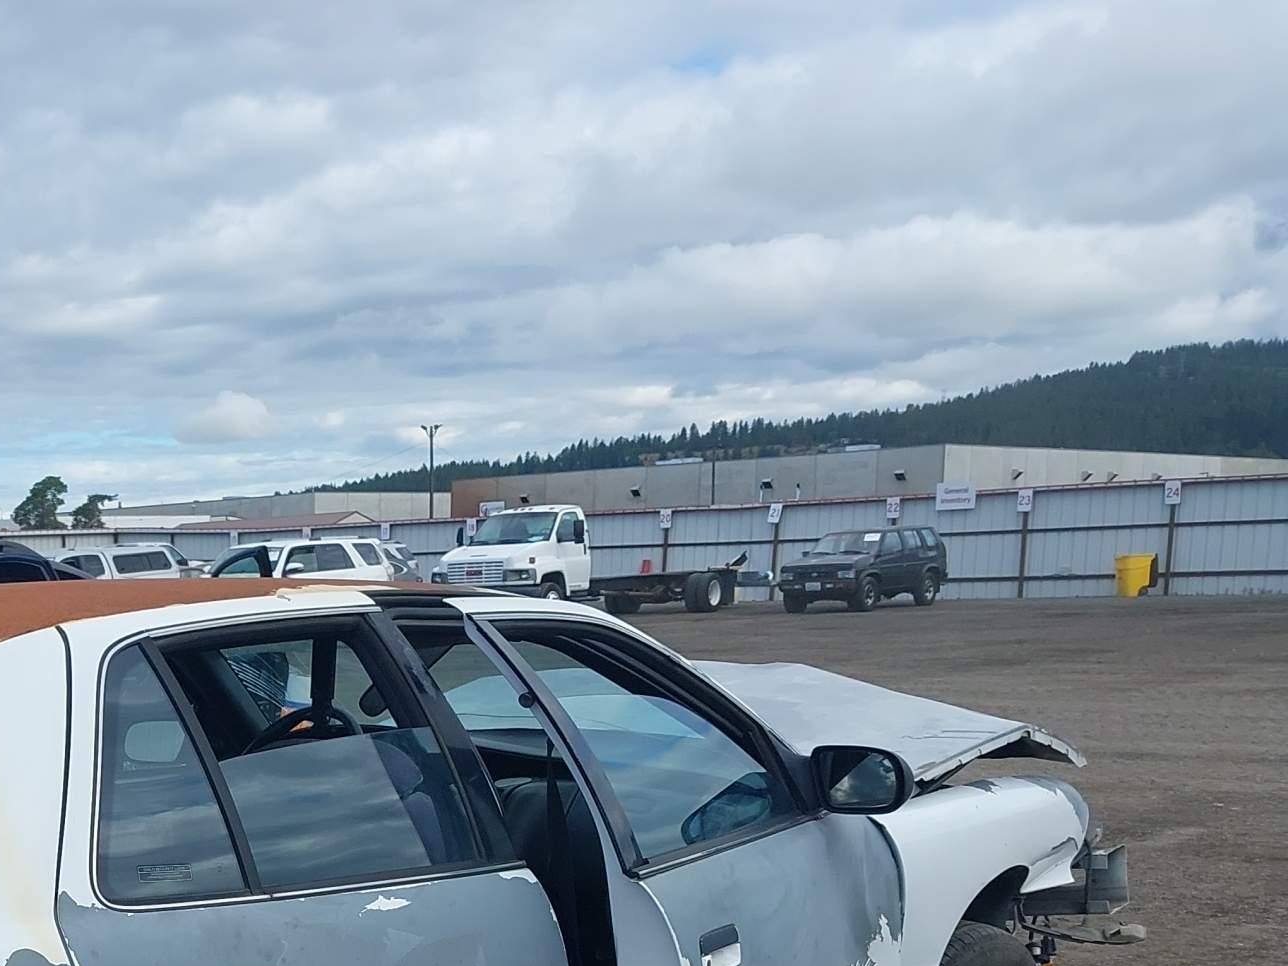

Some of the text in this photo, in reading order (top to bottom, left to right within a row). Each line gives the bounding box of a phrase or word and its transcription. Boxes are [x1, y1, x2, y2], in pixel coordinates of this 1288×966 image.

[1166, 487, 1180, 498] 24
[1018, 495, 1031, 506] 23
[887, 502, 900, 513] 22
[660, 513, 672, 523] 20
[770, 509, 781, 519] 21
